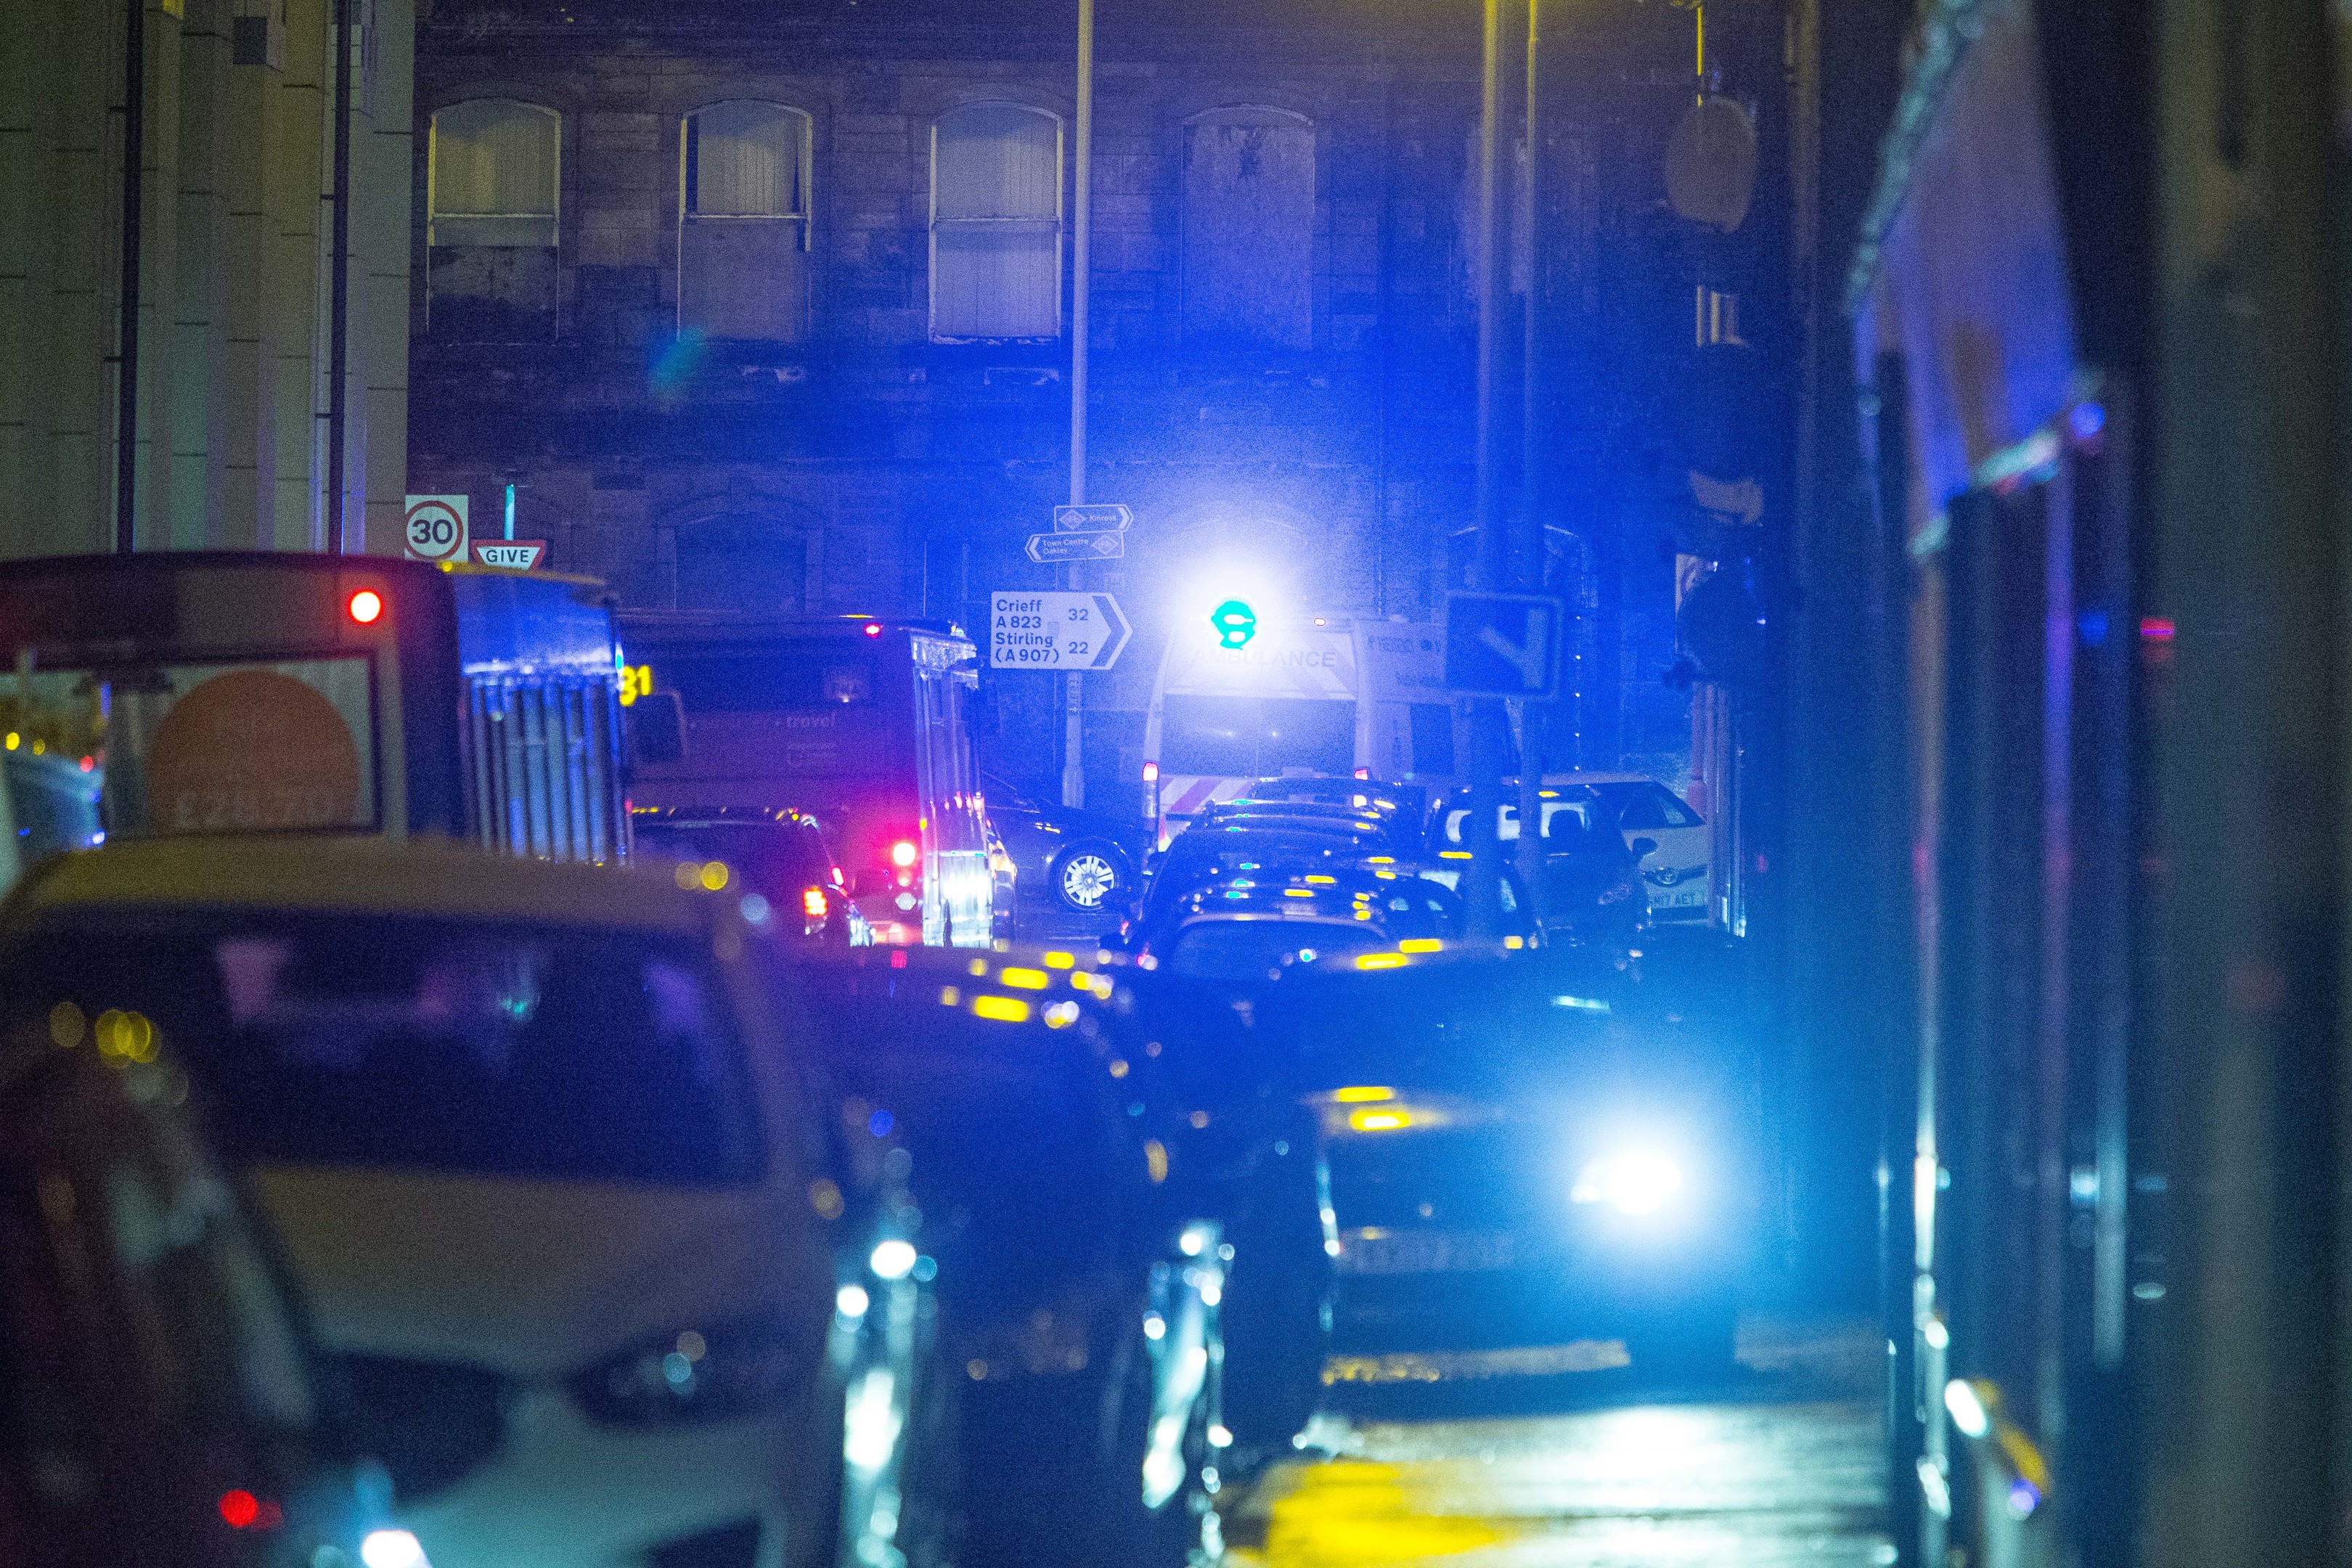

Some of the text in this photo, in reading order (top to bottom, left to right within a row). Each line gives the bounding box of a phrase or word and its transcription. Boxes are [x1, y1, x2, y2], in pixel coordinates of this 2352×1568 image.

[1090, 514, 1116, 523] Kinross
[412, 519, 453, 544] 30
[1042, 539, 1061, 548] Town
[486, 550, 529, 563] GIVE
[997, 599, 1042, 612] Crieff
[1068, 608, 1088, 621] 32
[995, 632, 1053, 648] Stirling
[1068, 641, 1088, 654] 22
[1191, 648, 1337, 668] AMBULANCE
[786, 710, 836, 728] travel
